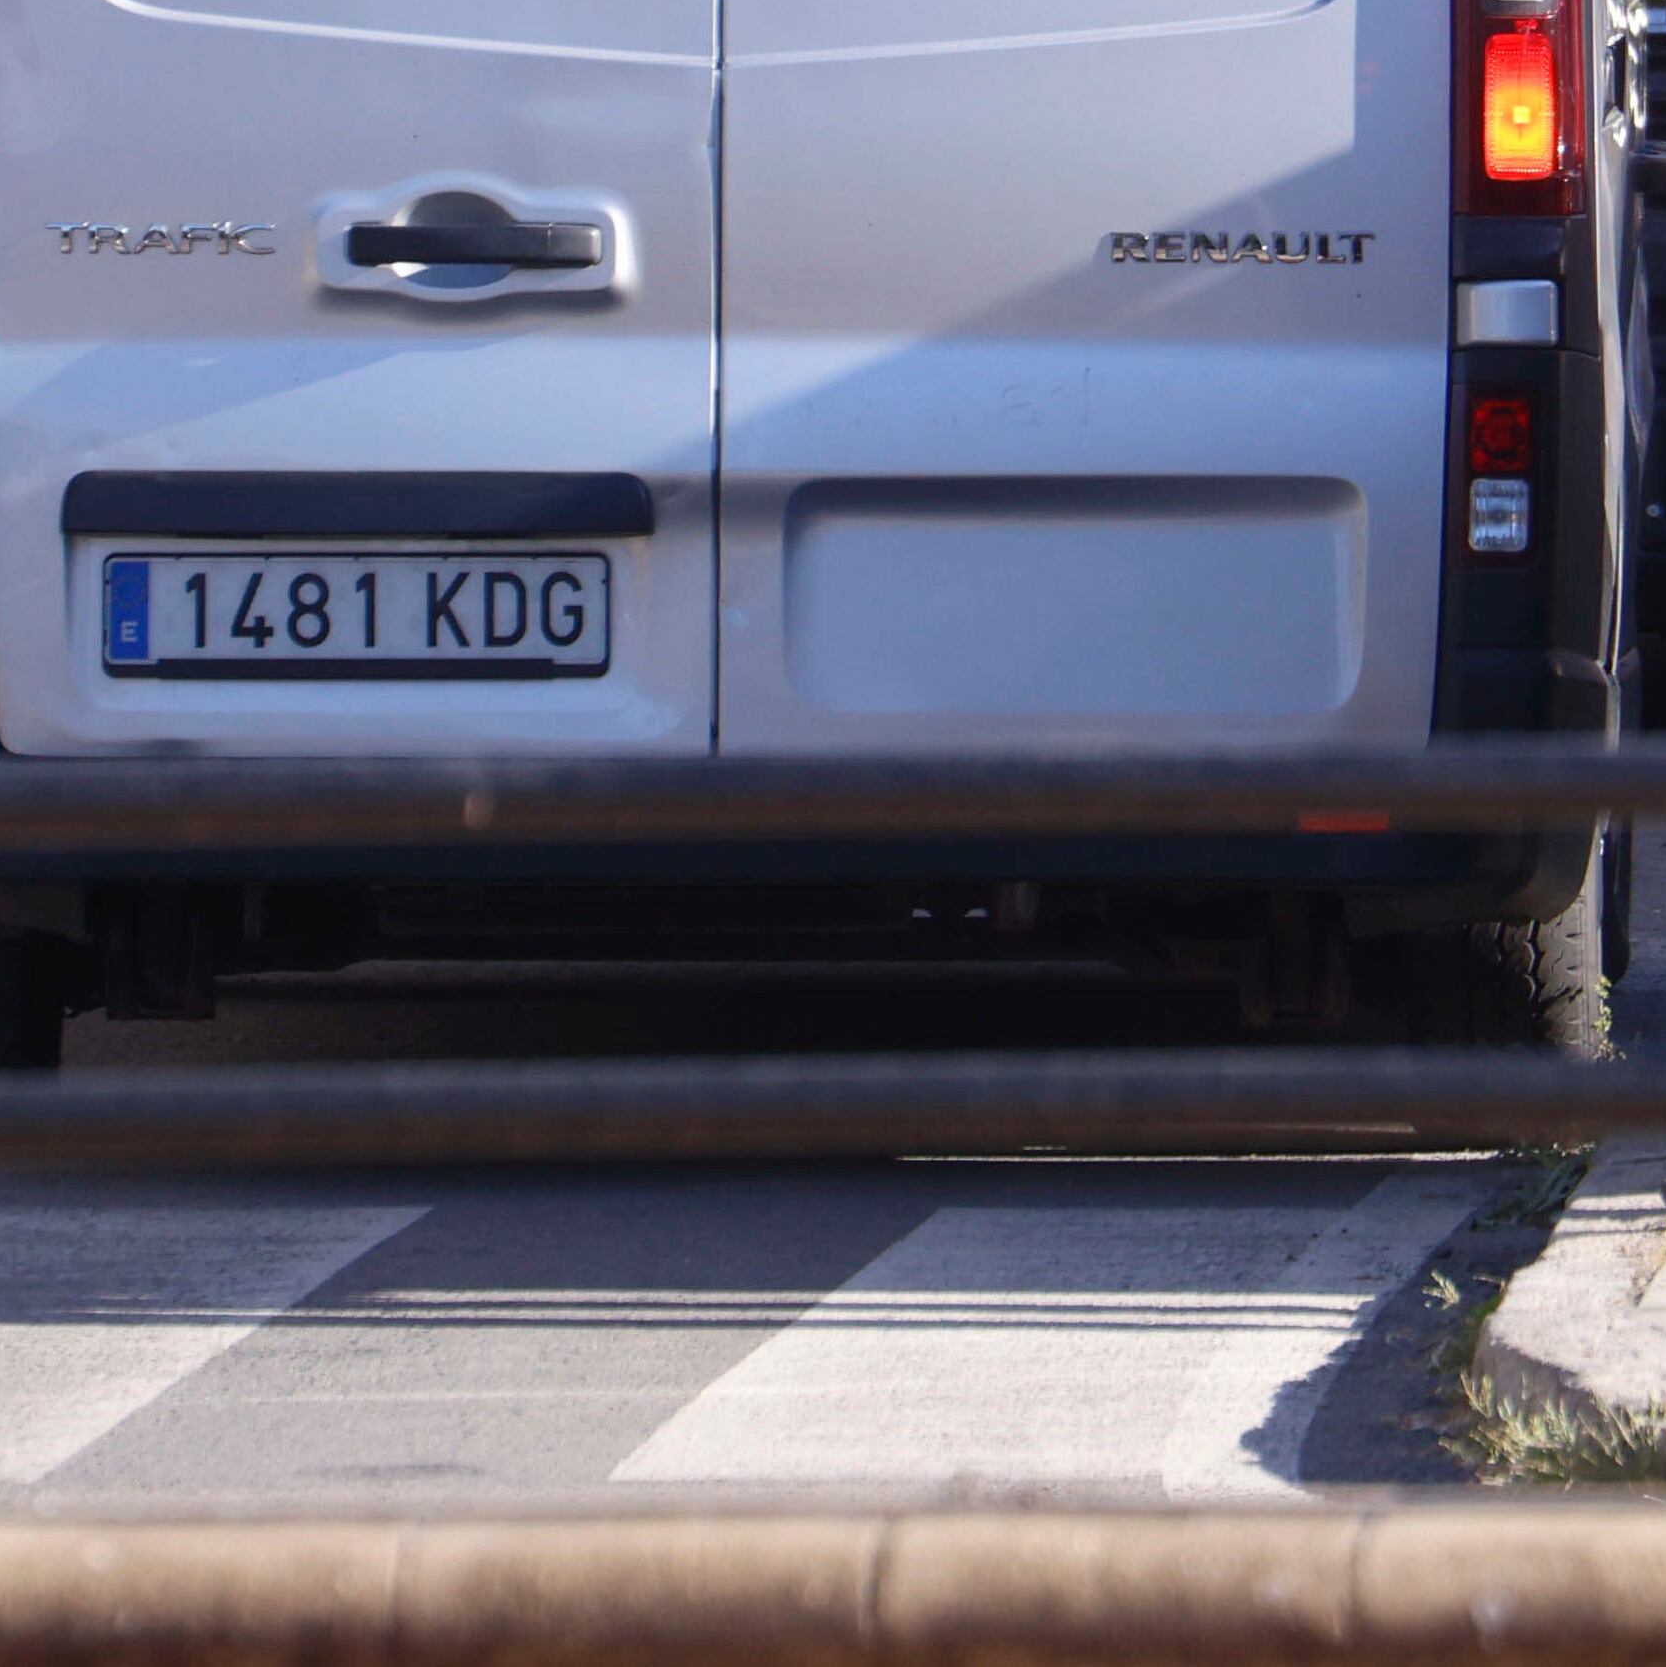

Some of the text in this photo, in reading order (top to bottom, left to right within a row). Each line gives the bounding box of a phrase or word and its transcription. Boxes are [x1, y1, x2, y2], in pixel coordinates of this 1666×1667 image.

[46, 220, 277, 254] TRAFIC
[1109, 231, 1376, 263] RENAULT
[184, 571, 585, 648] 1481 KDG
[120, 620, 139, 643] E
